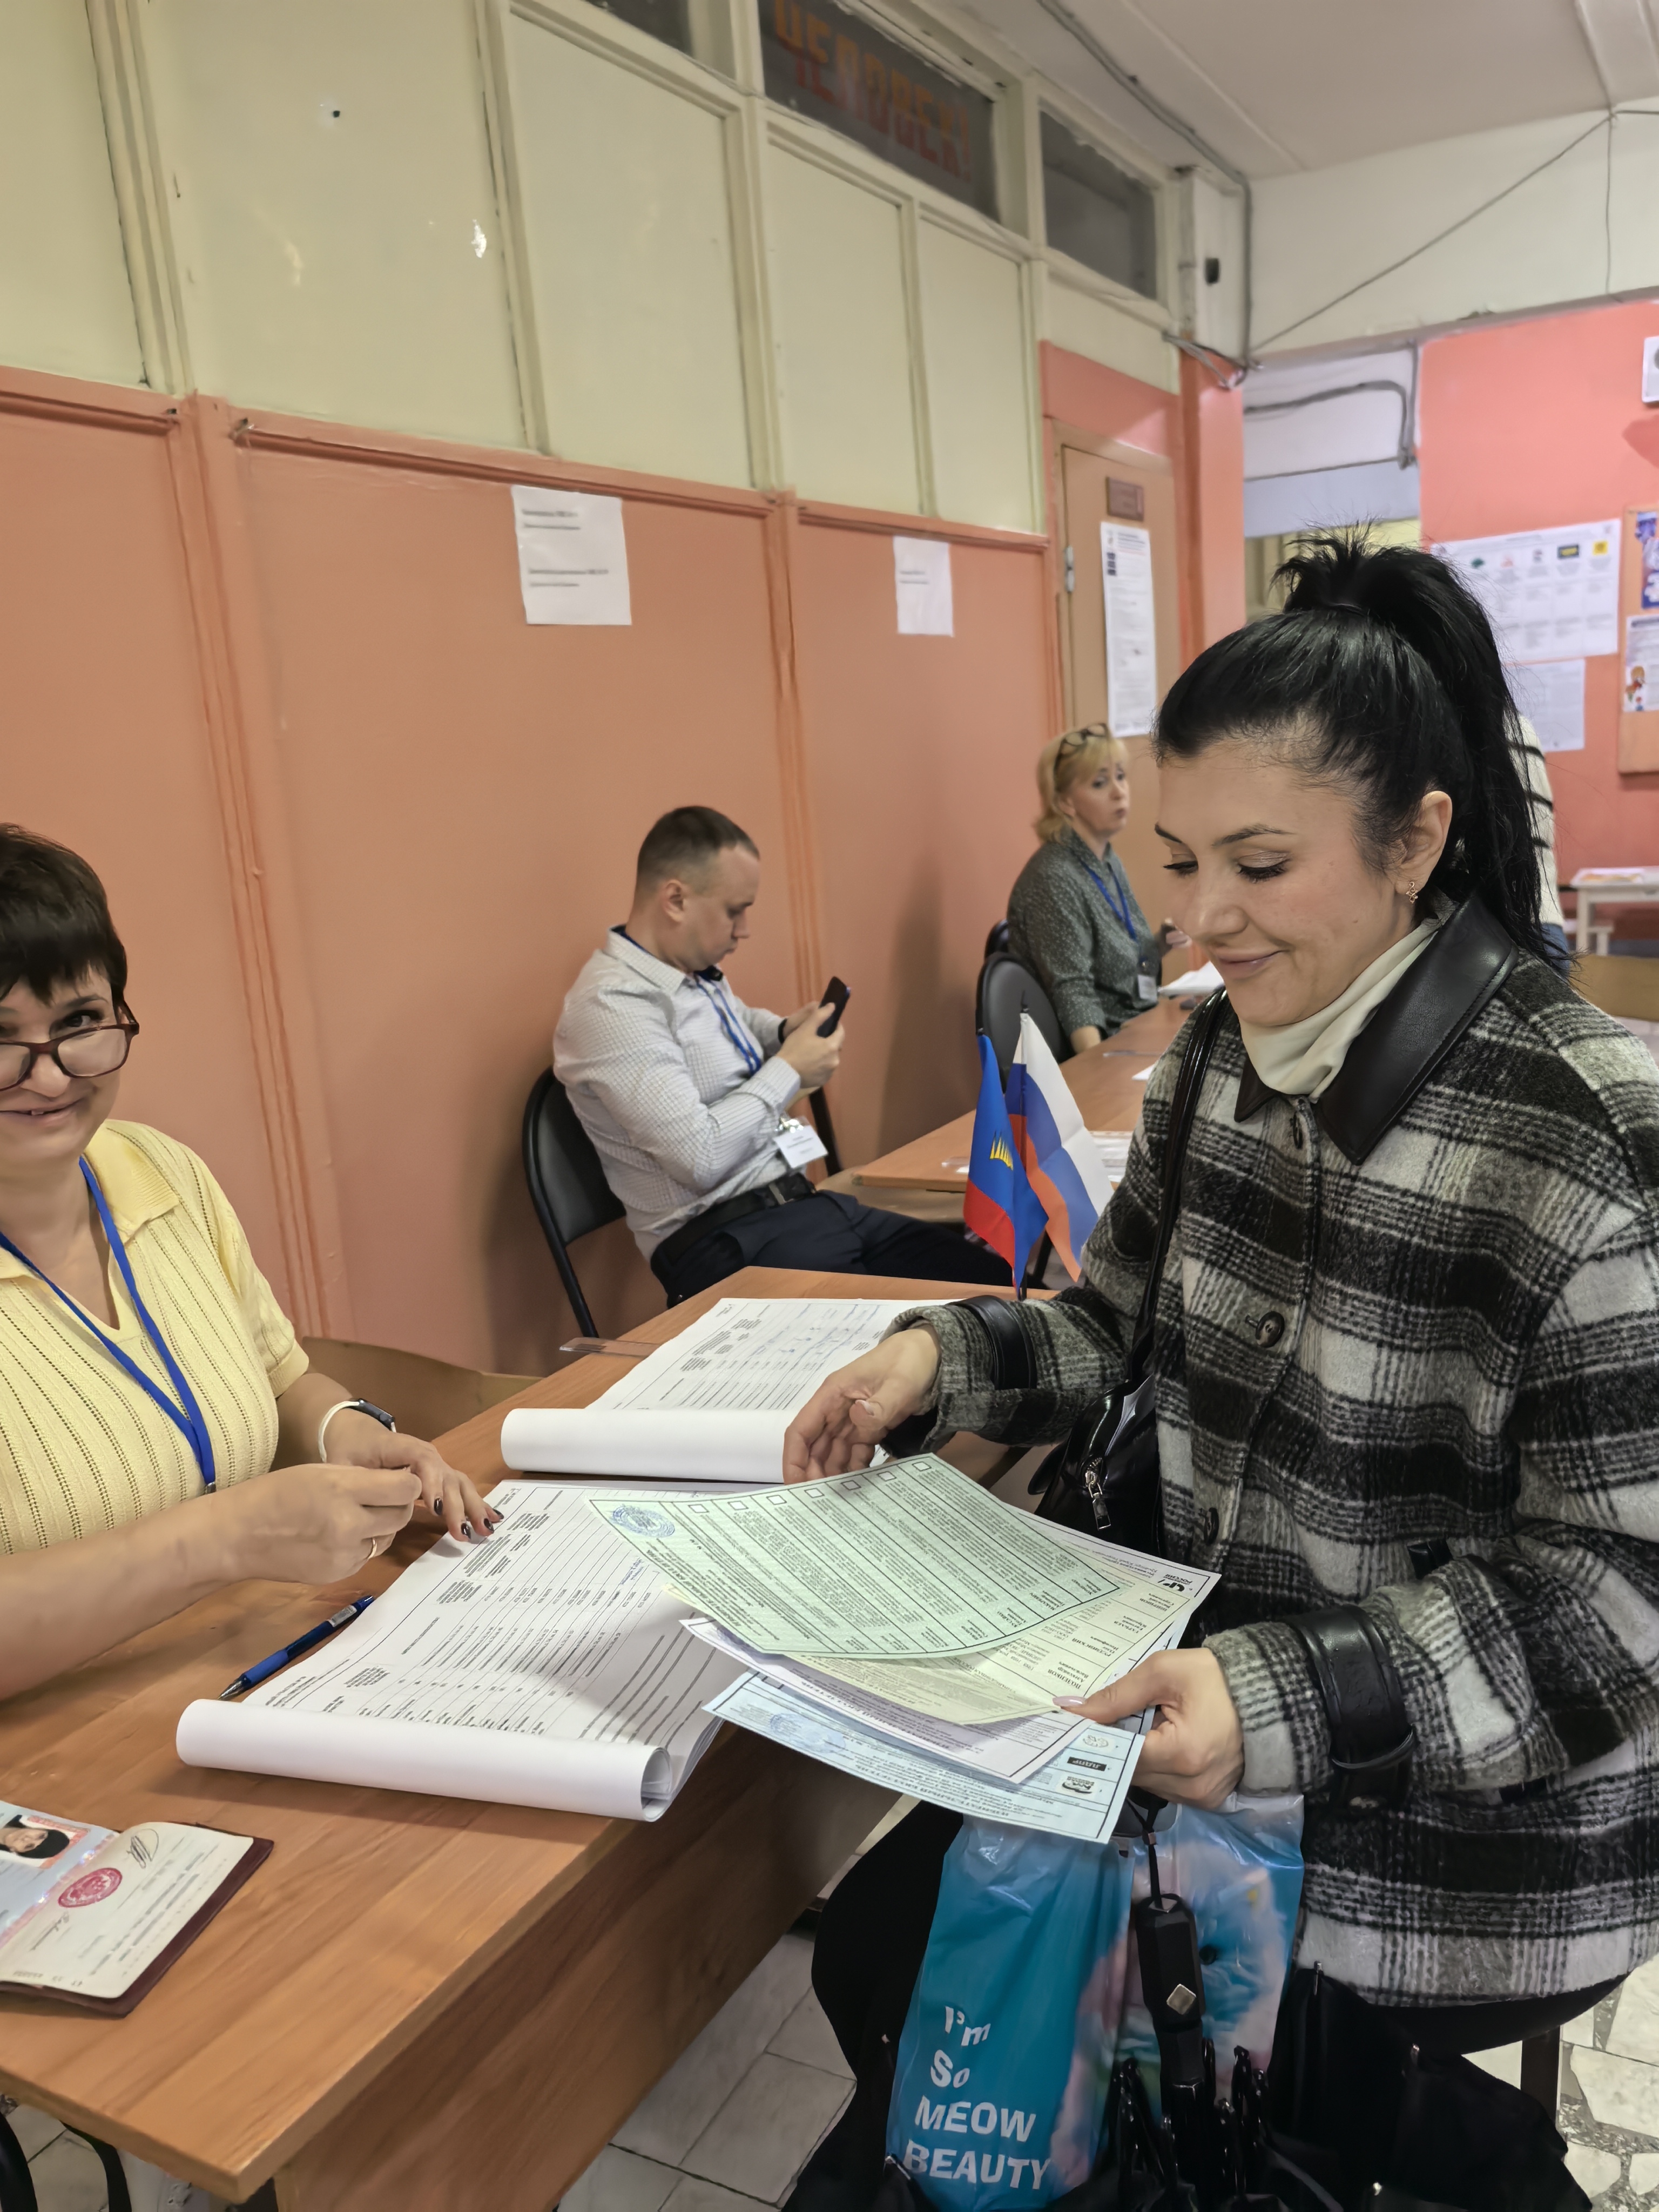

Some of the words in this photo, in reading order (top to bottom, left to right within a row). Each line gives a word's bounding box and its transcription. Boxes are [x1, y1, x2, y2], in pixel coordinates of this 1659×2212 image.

[945, 2006, 991, 2046] I'm
[930, 2049, 970, 2088] So
[915, 2095, 1036, 2142] MEOW
[903, 2139, 1051, 2190] BEAUTY
